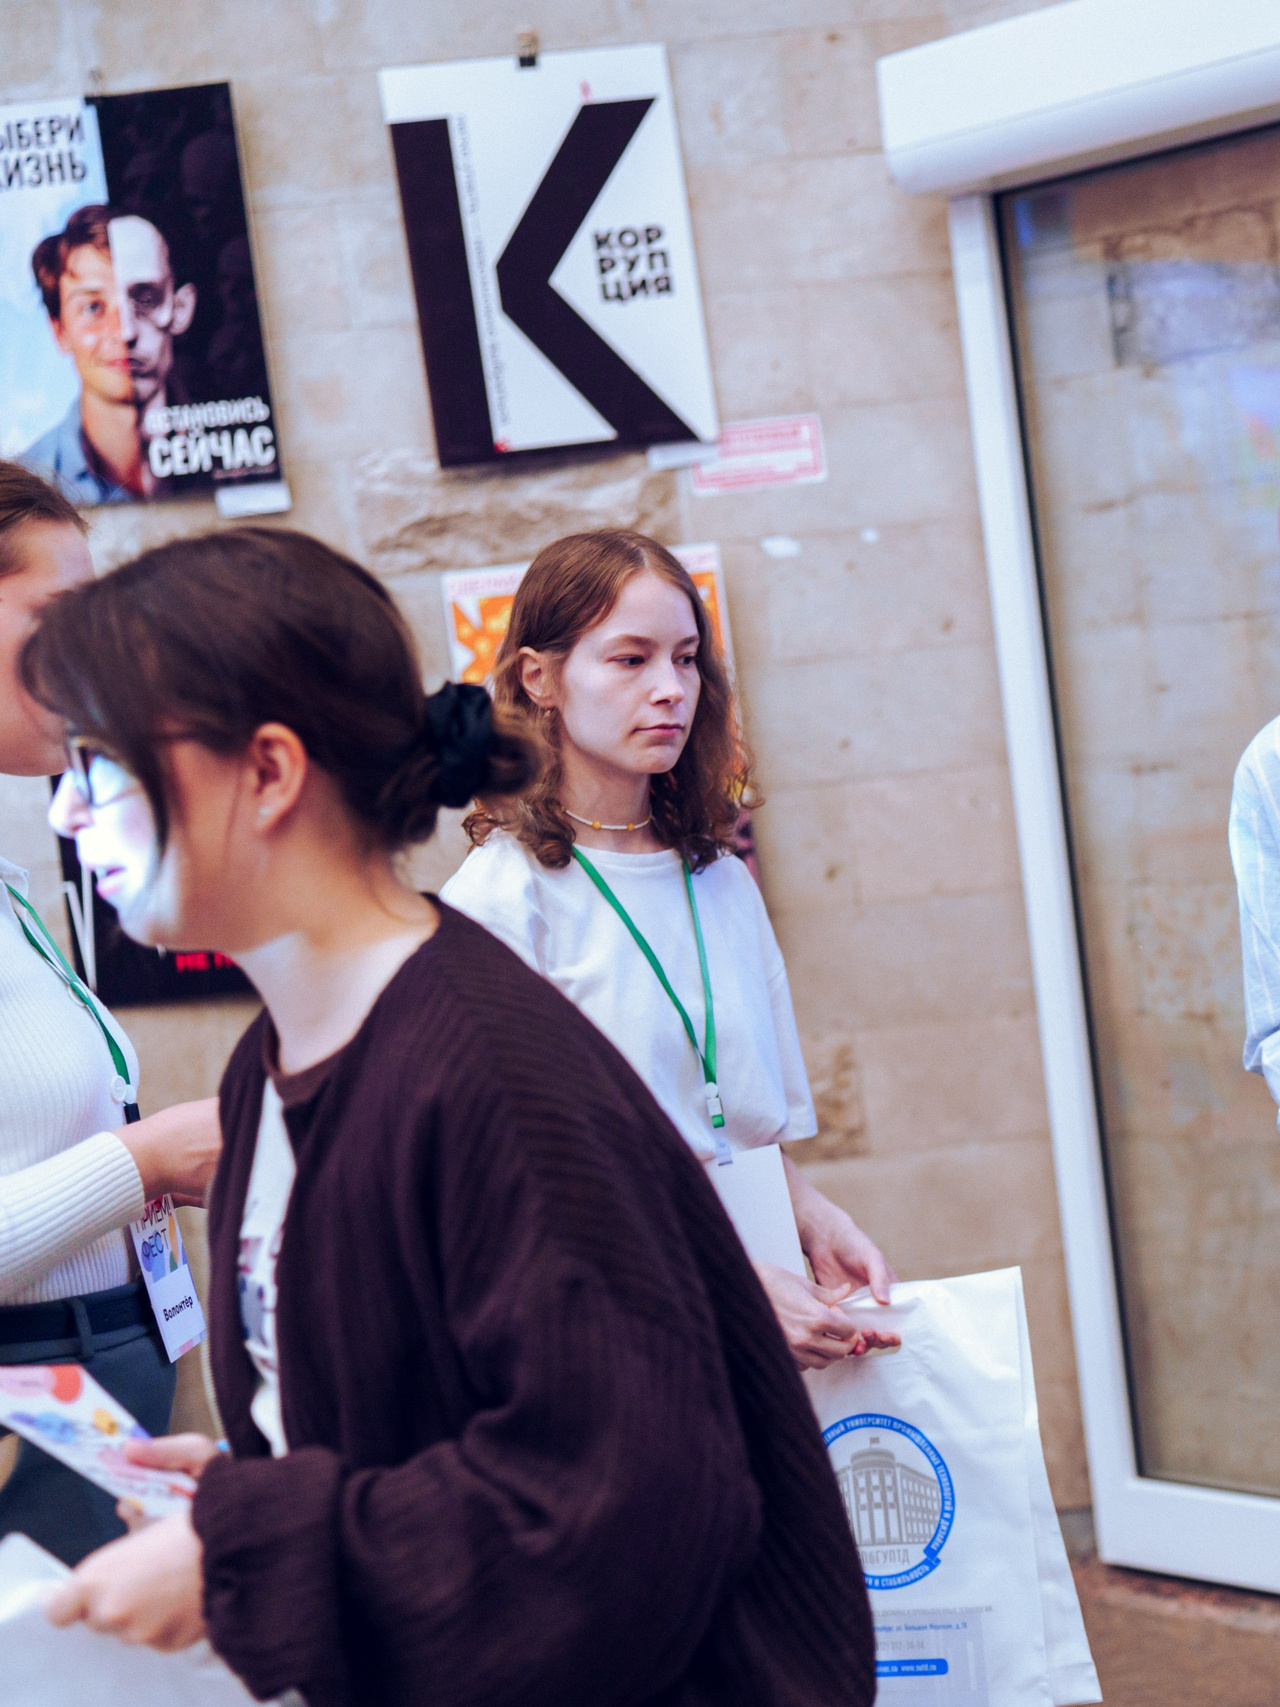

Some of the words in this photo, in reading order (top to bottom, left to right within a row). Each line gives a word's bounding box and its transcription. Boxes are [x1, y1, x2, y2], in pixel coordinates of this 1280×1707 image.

[0, 115, 85, 152] ЫБЕРИ
[594, 227, 663, 250] КОР
[599, 250, 669, 275] РУП
[601, 276, 672, 303] ЦИЯ
[149, 425, 276, 478] СЕЙЧАС
[141, 1227, 169, 1261] ФЕСТ
[163, 1296, 194, 1321] Волонтёр
